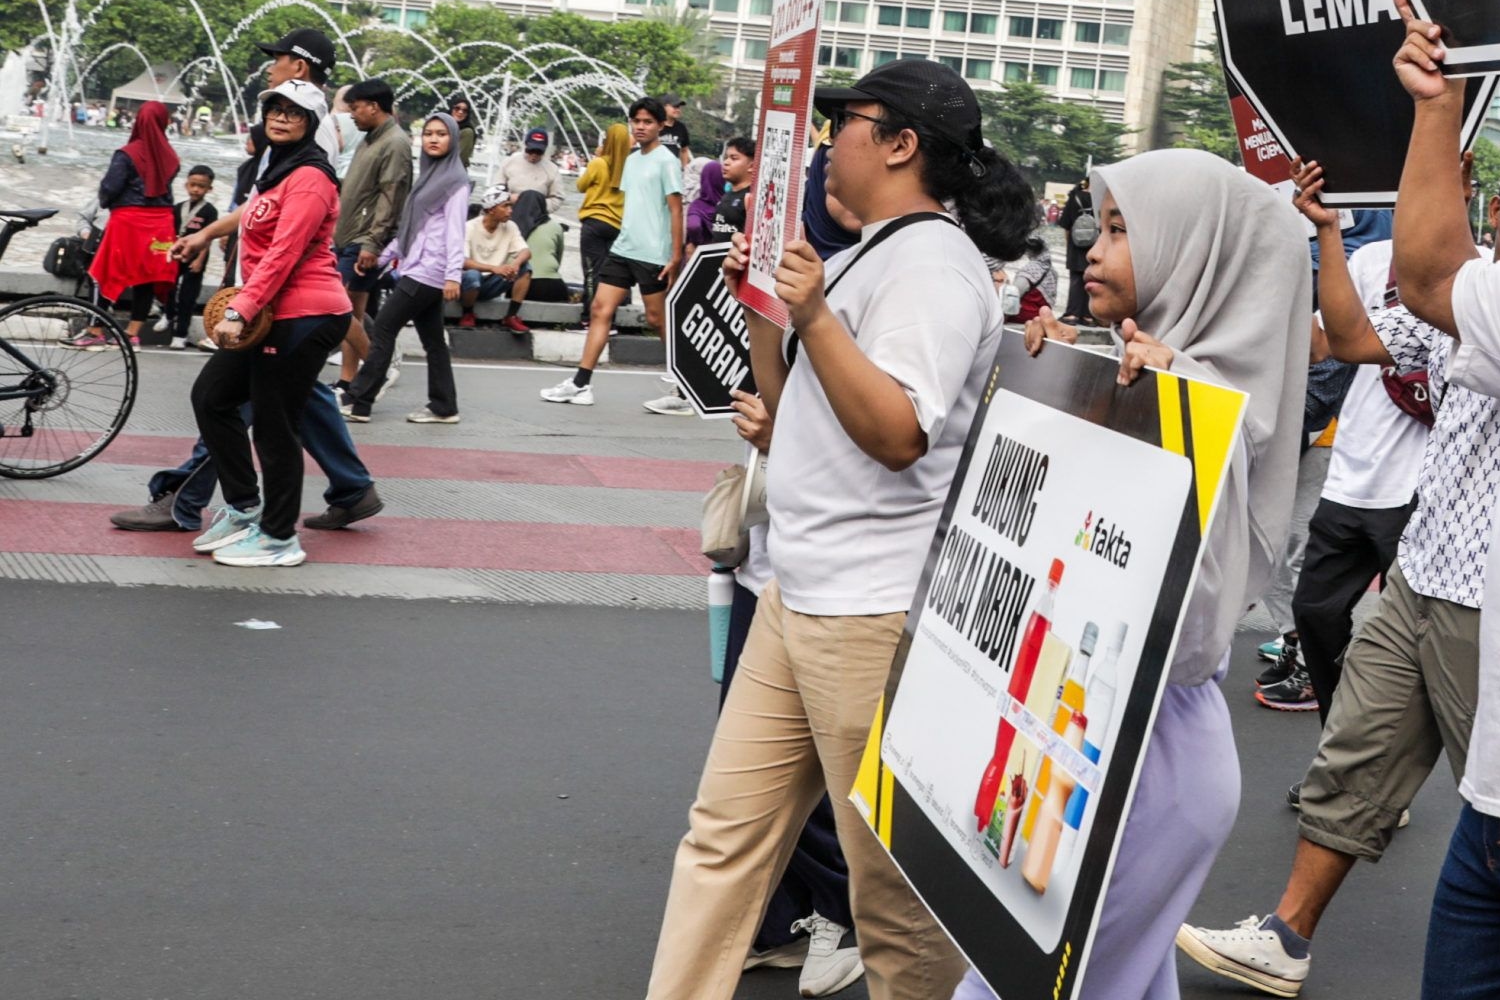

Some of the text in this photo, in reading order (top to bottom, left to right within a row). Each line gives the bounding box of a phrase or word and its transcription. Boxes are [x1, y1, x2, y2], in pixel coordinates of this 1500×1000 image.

[681, 303, 749, 396] GARAM
[971, 433, 1049, 547] DUKUNG
[1090, 517, 1132, 569] fakta
[928, 524, 988, 634] CUKAI
[967, 551, 1036, 673] MBDK
